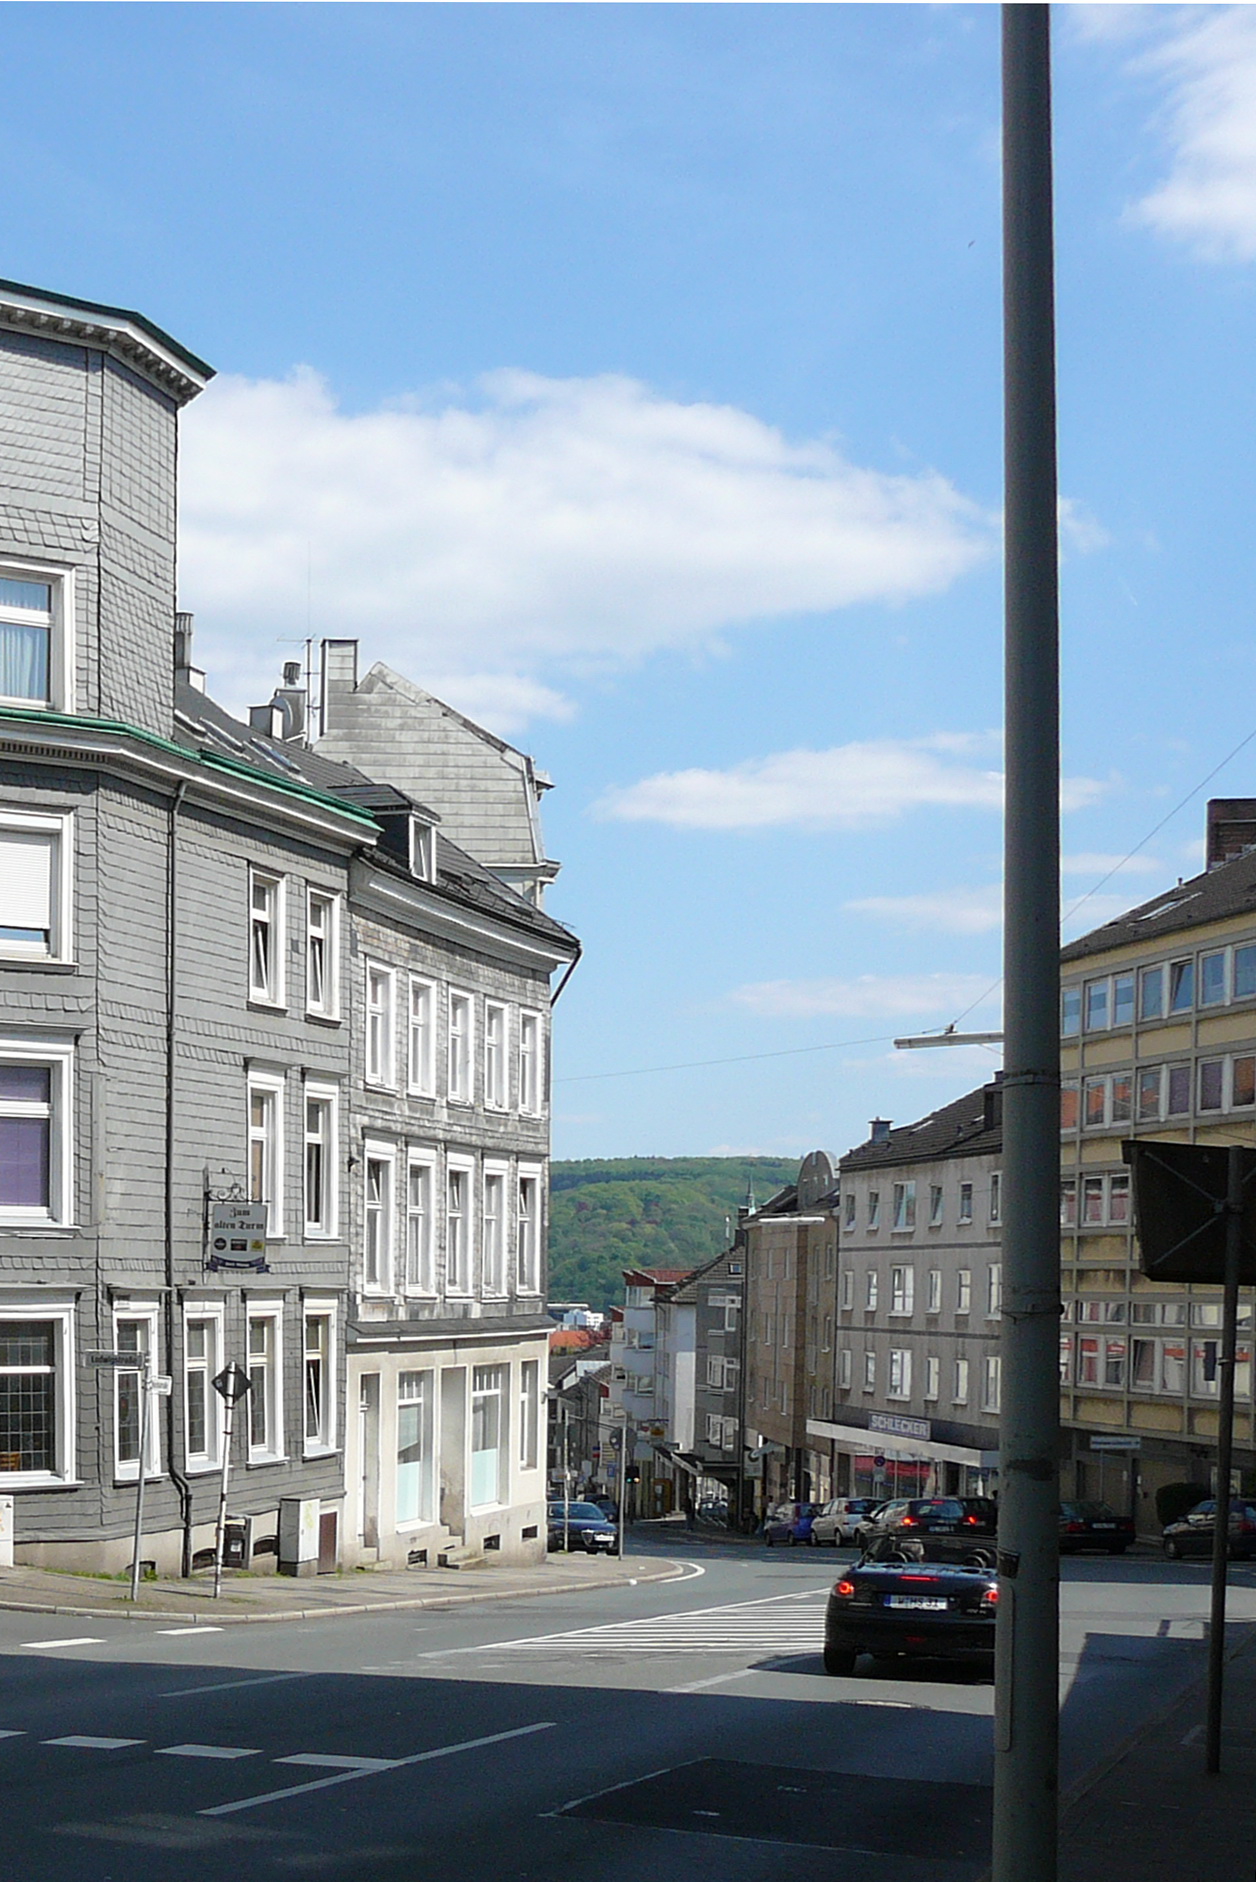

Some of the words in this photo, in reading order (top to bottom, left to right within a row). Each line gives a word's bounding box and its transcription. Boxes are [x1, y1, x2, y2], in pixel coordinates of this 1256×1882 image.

[214, 1220, 236, 1230] alten
[237, 1220, 264, 1230] Turm
[871, 1414, 928, 1436] SCHLECKER
